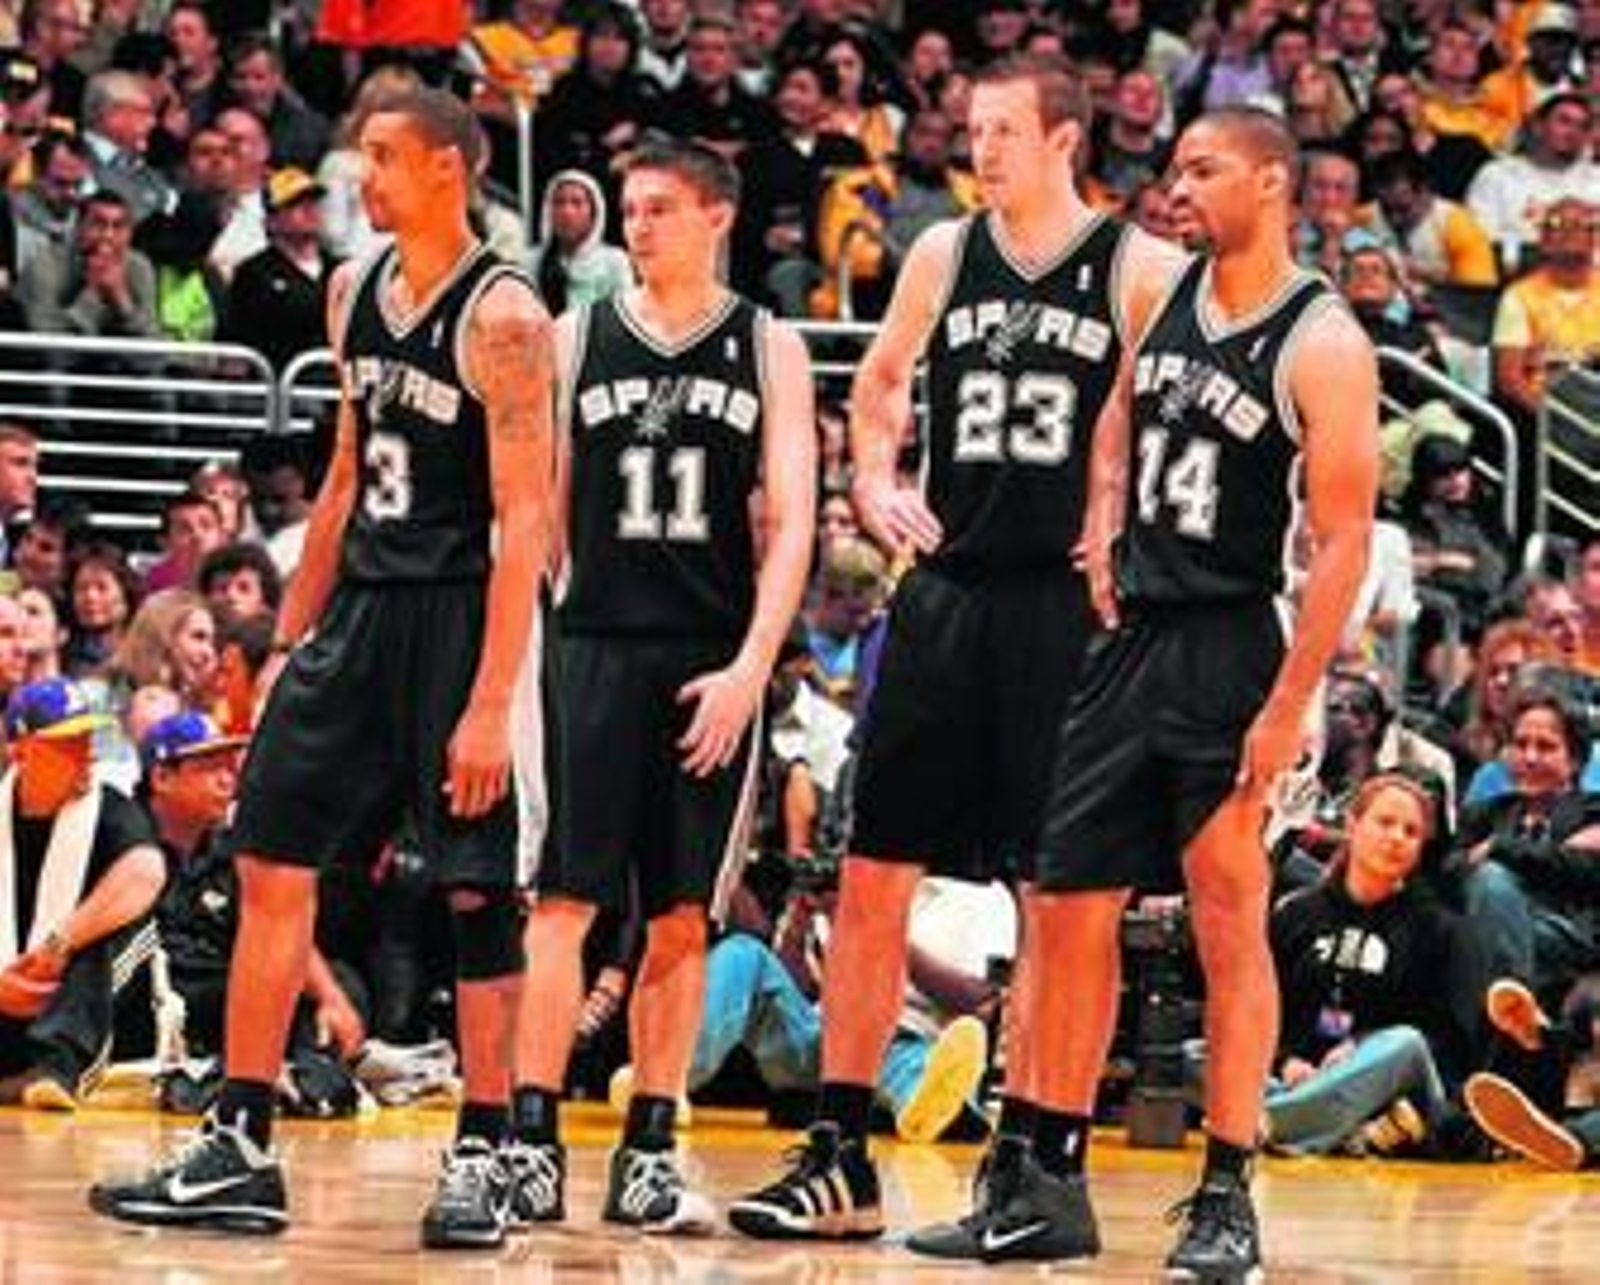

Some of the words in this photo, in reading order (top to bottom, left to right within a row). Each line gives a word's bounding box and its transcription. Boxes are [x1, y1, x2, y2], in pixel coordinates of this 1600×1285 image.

[954, 371, 1077, 463] 23
[364, 431, 411, 520] 3
[617, 445, 709, 539] 11
[1137, 425, 1221, 540] 14
